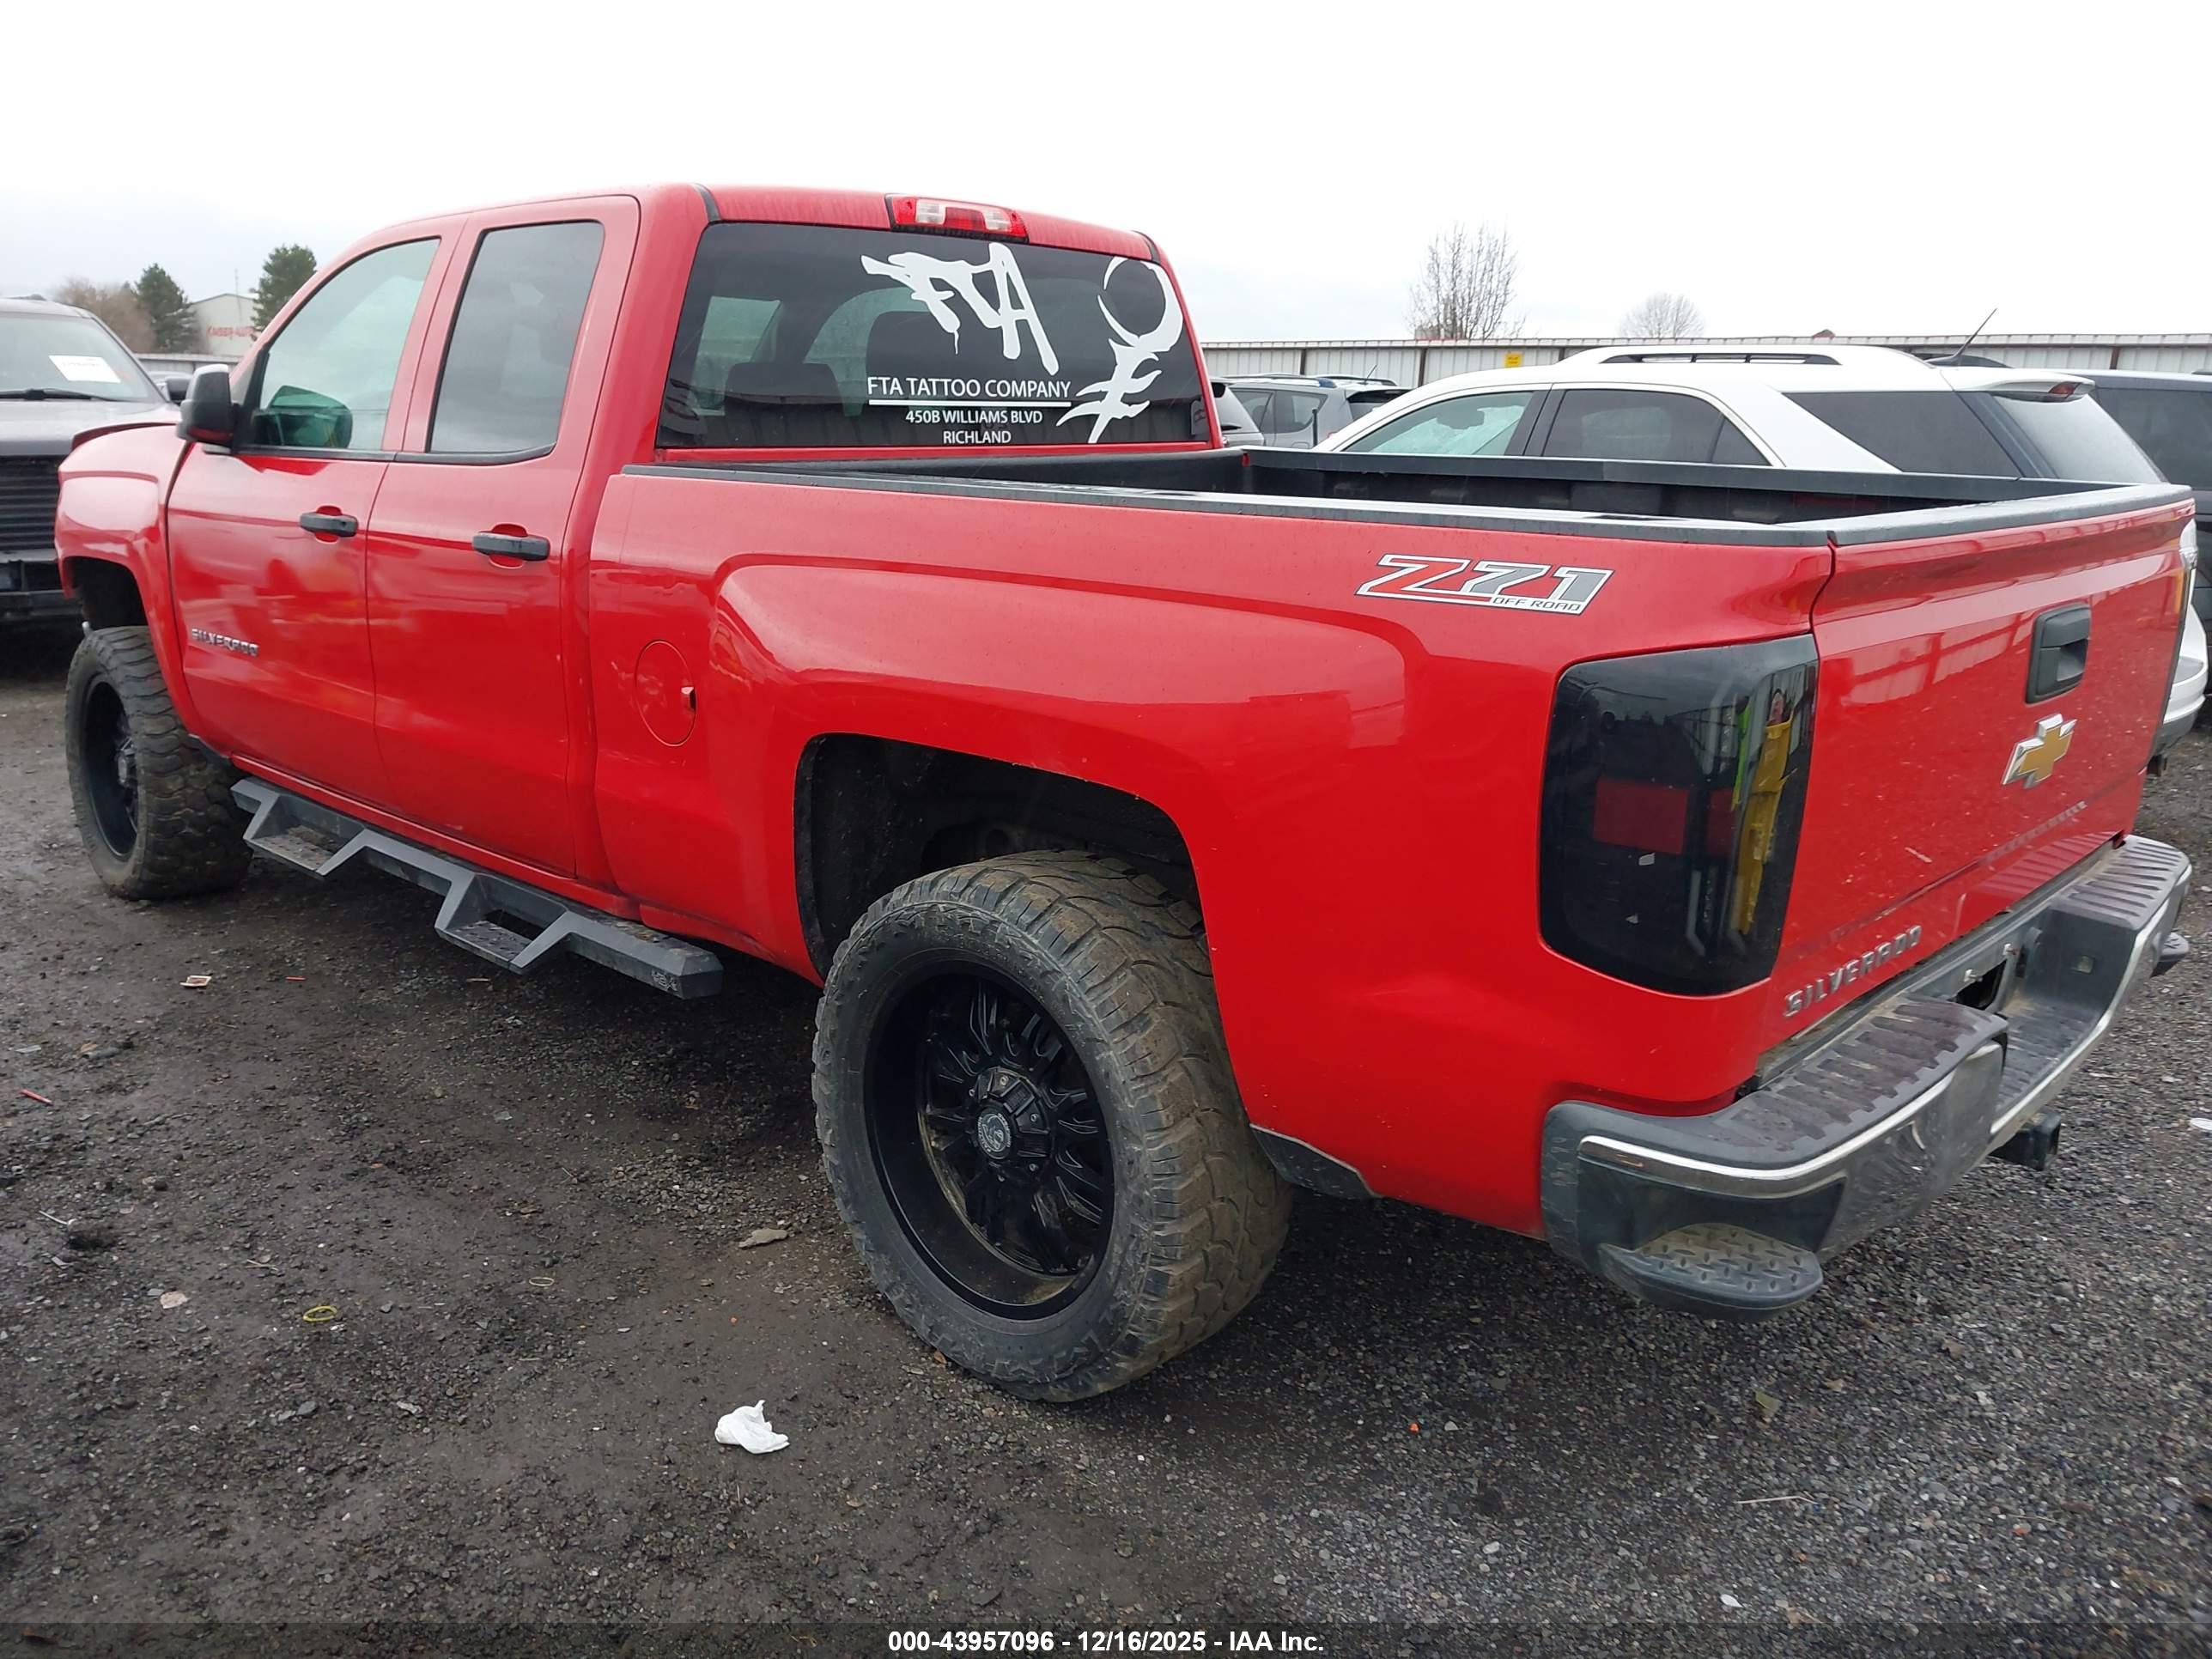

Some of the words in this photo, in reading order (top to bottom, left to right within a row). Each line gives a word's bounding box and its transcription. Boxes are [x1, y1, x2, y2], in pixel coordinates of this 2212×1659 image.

[867, 376, 904, 395] FTA
[906, 378, 981, 398] TATTOO
[985, 379, 1072, 398] COMPANY
[905, 410, 941, 424] 450B
[943, 410, 1008, 424] WILLIAMS
[1011, 410, 1043, 424] BLVD
[943, 430, 1012, 444] RICHLAND
[1354, 553, 1615, 605] Z71
[1492, 596, 1528, 606] OFF
[1529, 599, 1583, 612] ROAD
[1784, 925, 1923, 1018] SILVERADO
